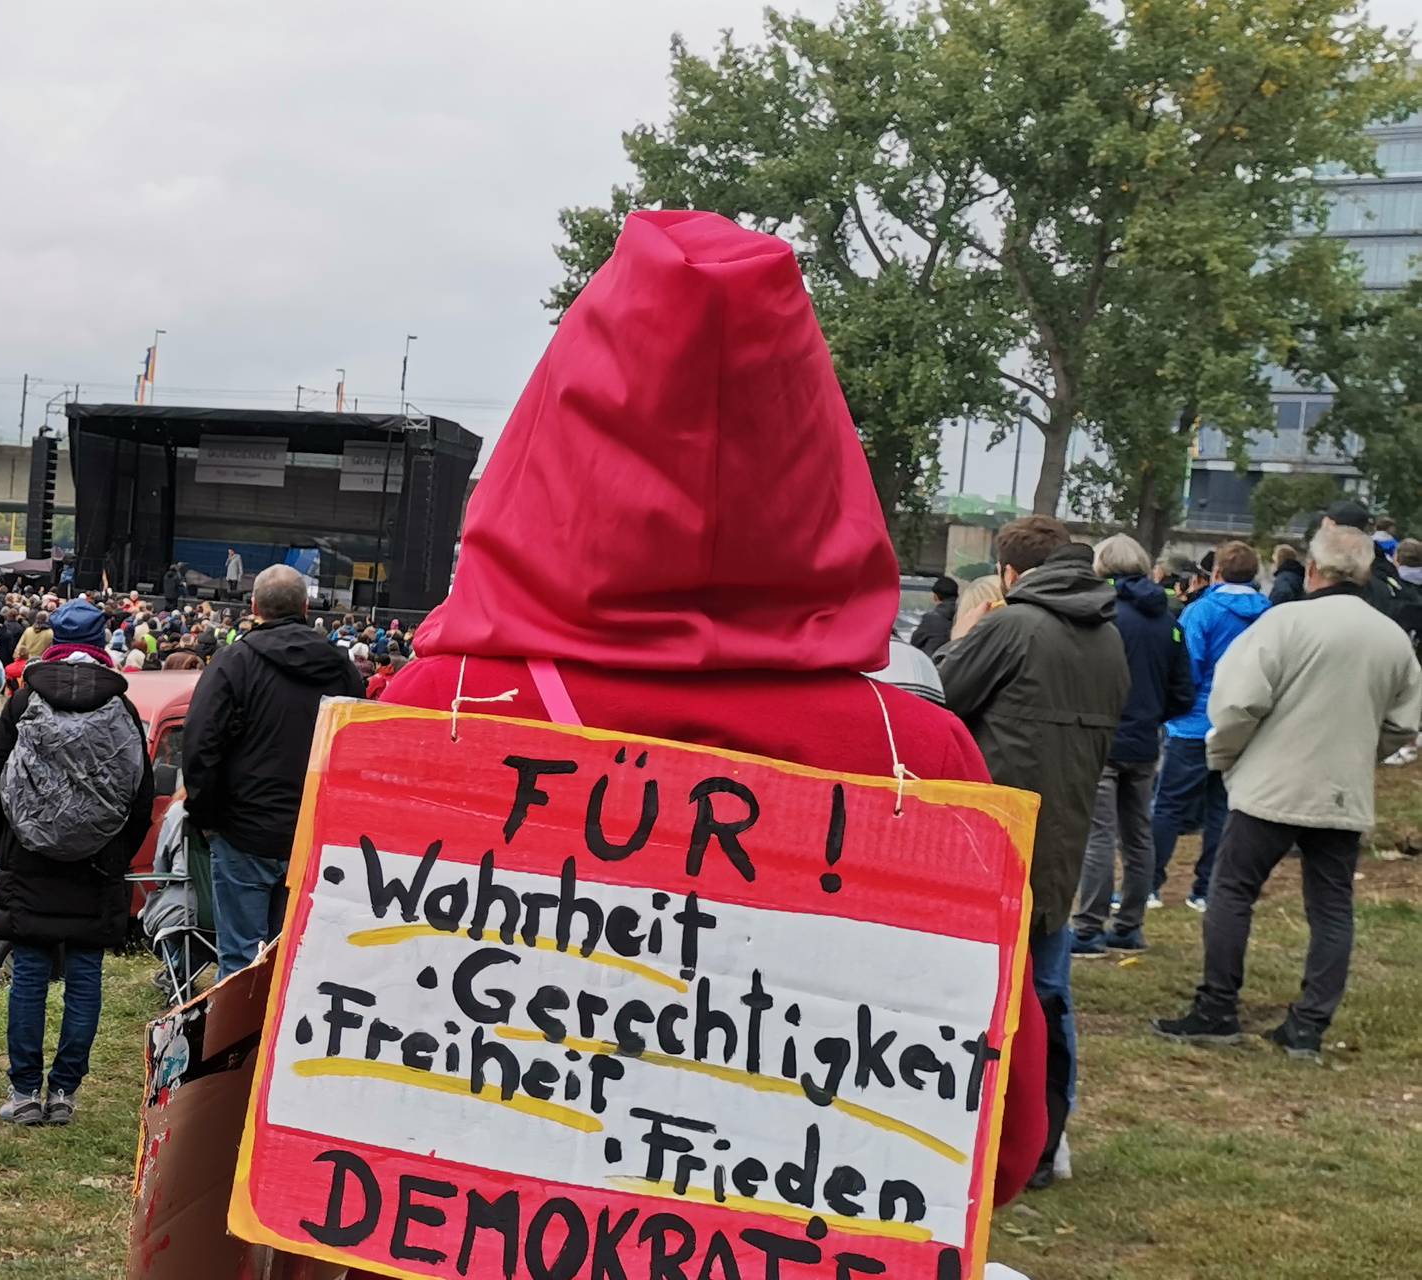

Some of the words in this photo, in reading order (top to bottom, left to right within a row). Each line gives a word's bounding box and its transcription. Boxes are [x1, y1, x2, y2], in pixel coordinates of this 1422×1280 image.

[504, 748, 759, 881] FÜR
[361, 837, 716, 981] Wahrheit
[318, 982, 624, 1113] Freiheit
[453, 948, 1000, 1111] Gerechtigkeit
[630, 1108, 926, 1222] Frieden
